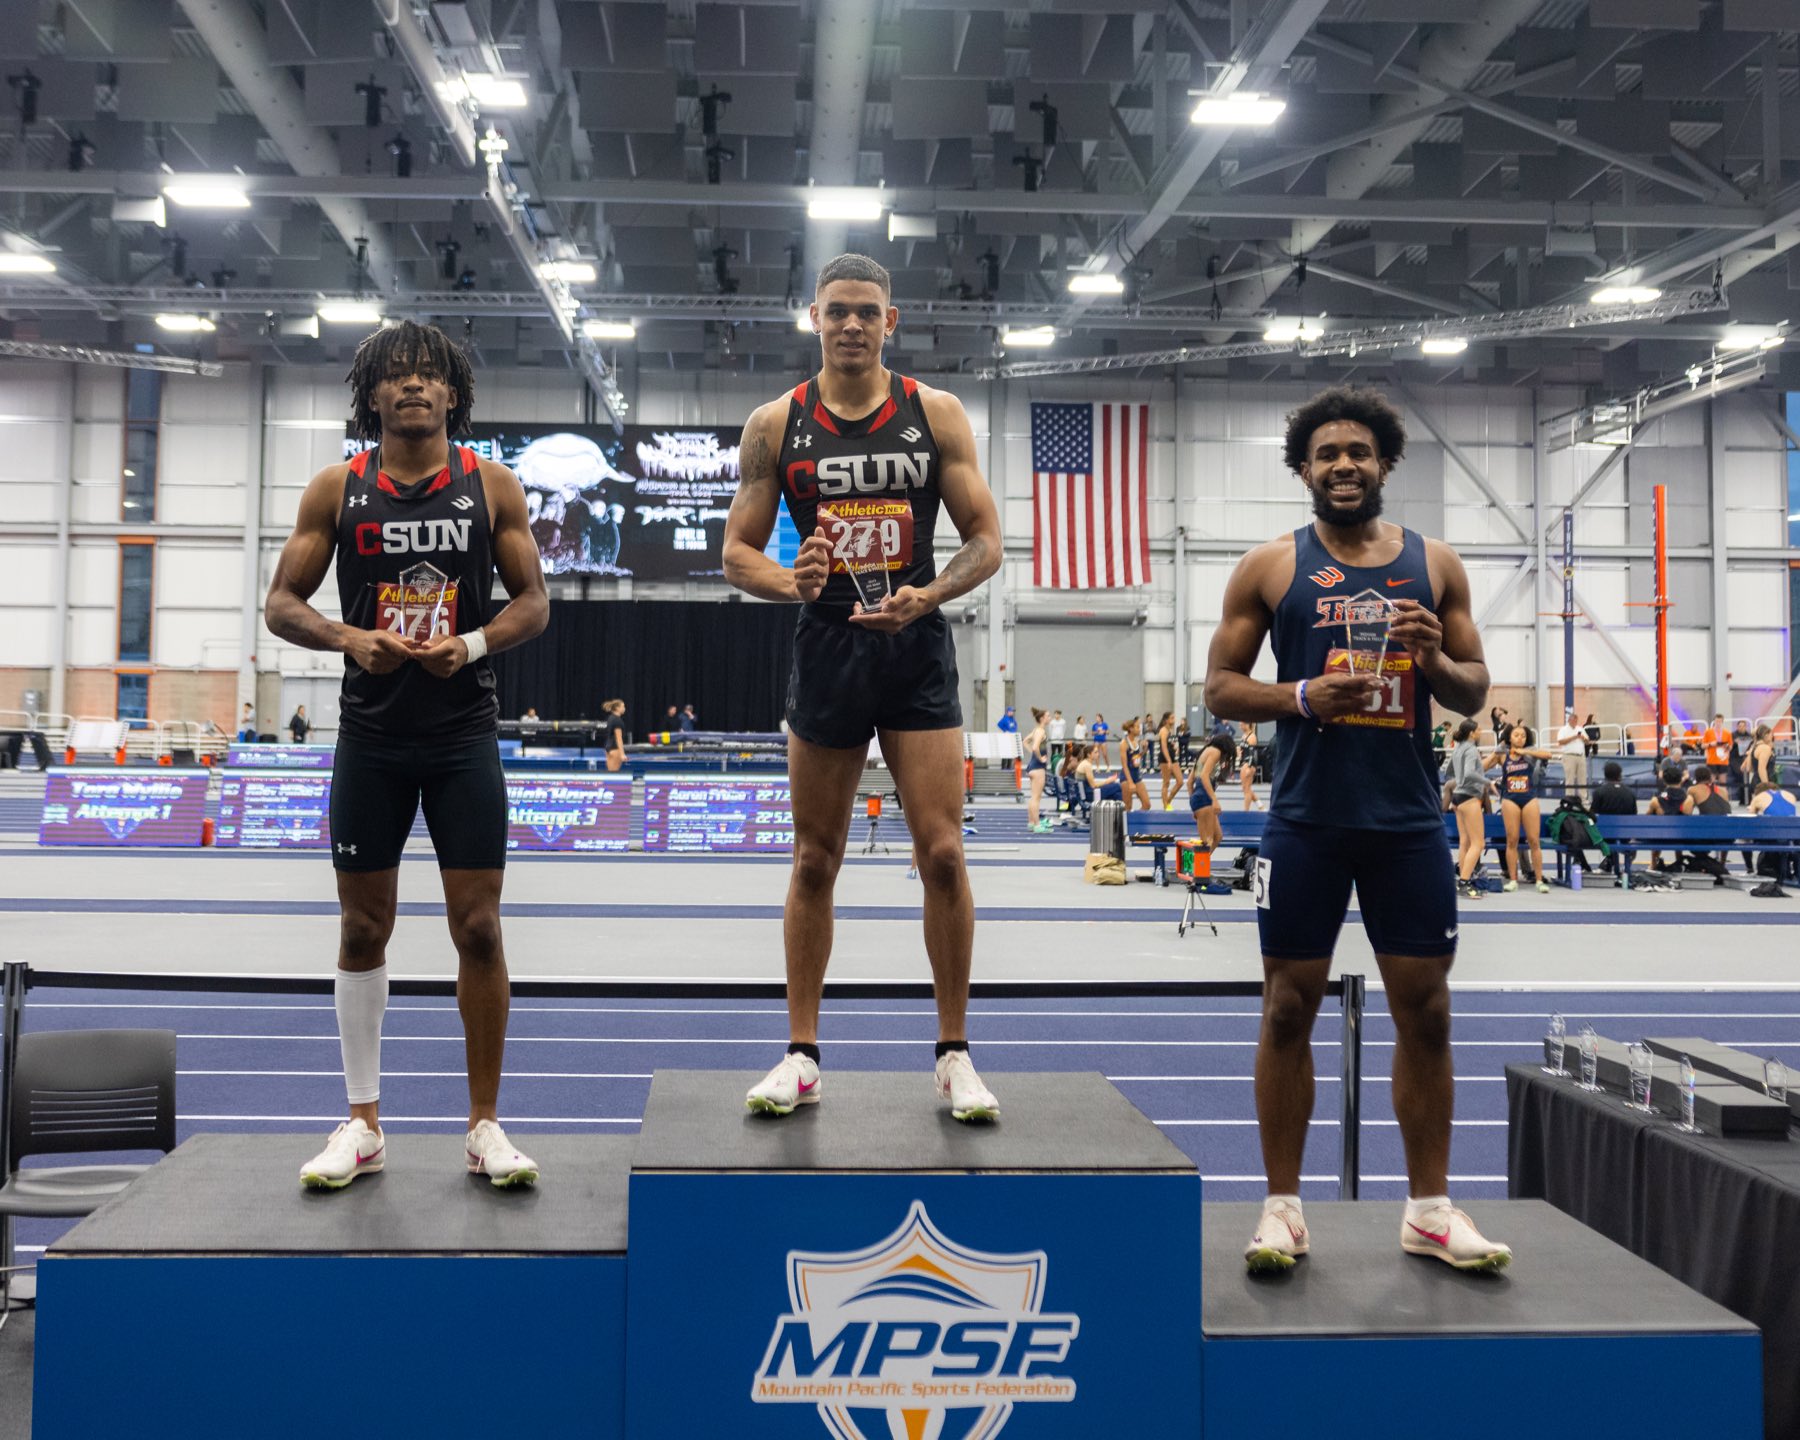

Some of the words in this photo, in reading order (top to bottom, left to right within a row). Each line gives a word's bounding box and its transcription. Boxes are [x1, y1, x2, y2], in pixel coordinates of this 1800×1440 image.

[786, 452, 931, 499] CSUN
[355, 519, 472, 556] CSUN
[832, 519, 901, 558] 279
[383, 607, 450, 642] 276
[73, 803, 160, 821] Attempt
[161, 804, 172, 819] 1
[508, 807, 582, 828] Attempt
[582, 807, 598, 825] 3
[1256, 861, 1266, 904] 5
[762, 1321, 1073, 1378] MPSF
[758, 1382, 842, 1397] Mountain
[847, 1382, 905, 1397] Pacific
[911, 1382, 970, 1398] Sports
[974, 1382, 1070, 1397] Federation
